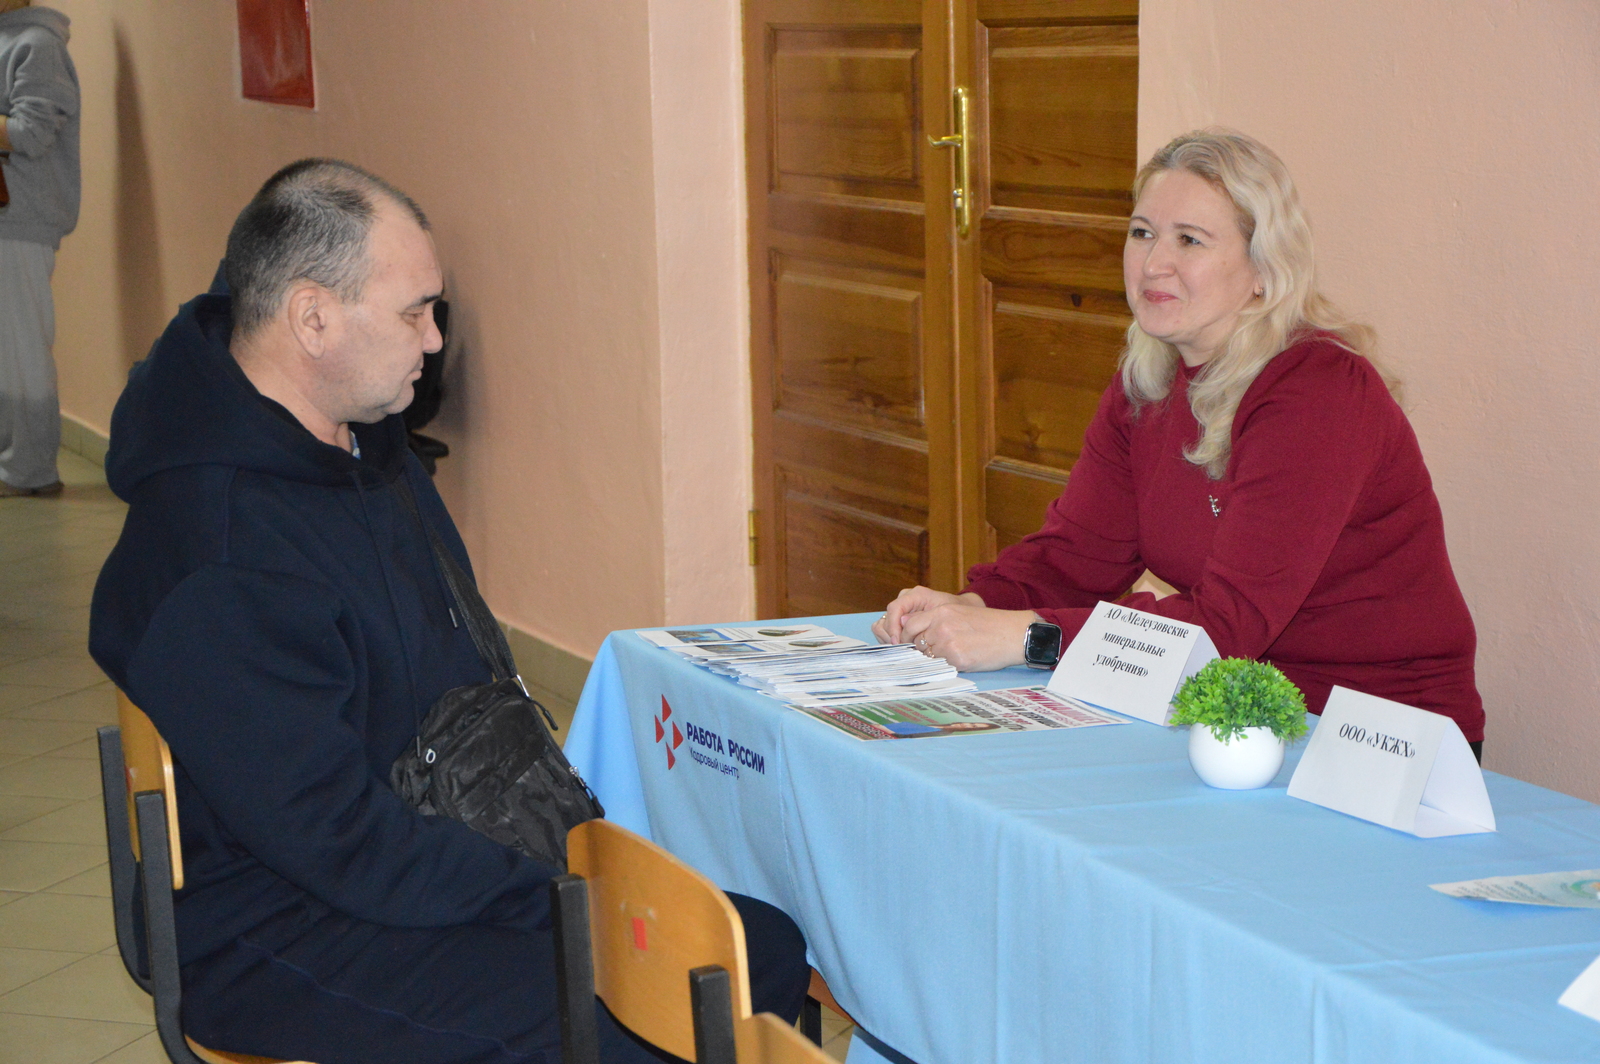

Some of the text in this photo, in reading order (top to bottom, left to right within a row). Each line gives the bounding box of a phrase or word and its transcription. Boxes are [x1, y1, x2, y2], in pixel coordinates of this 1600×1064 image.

[1103, 607, 1190, 639] АО «Мелеузовские
[1101, 631, 1166, 658] минеральные
[1092, 653, 1149, 678] удобрения»
[686, 722, 765, 775] РАБОТА РОССИИ
[1339, 723, 1416, 759] ООО «УКЖХ»
